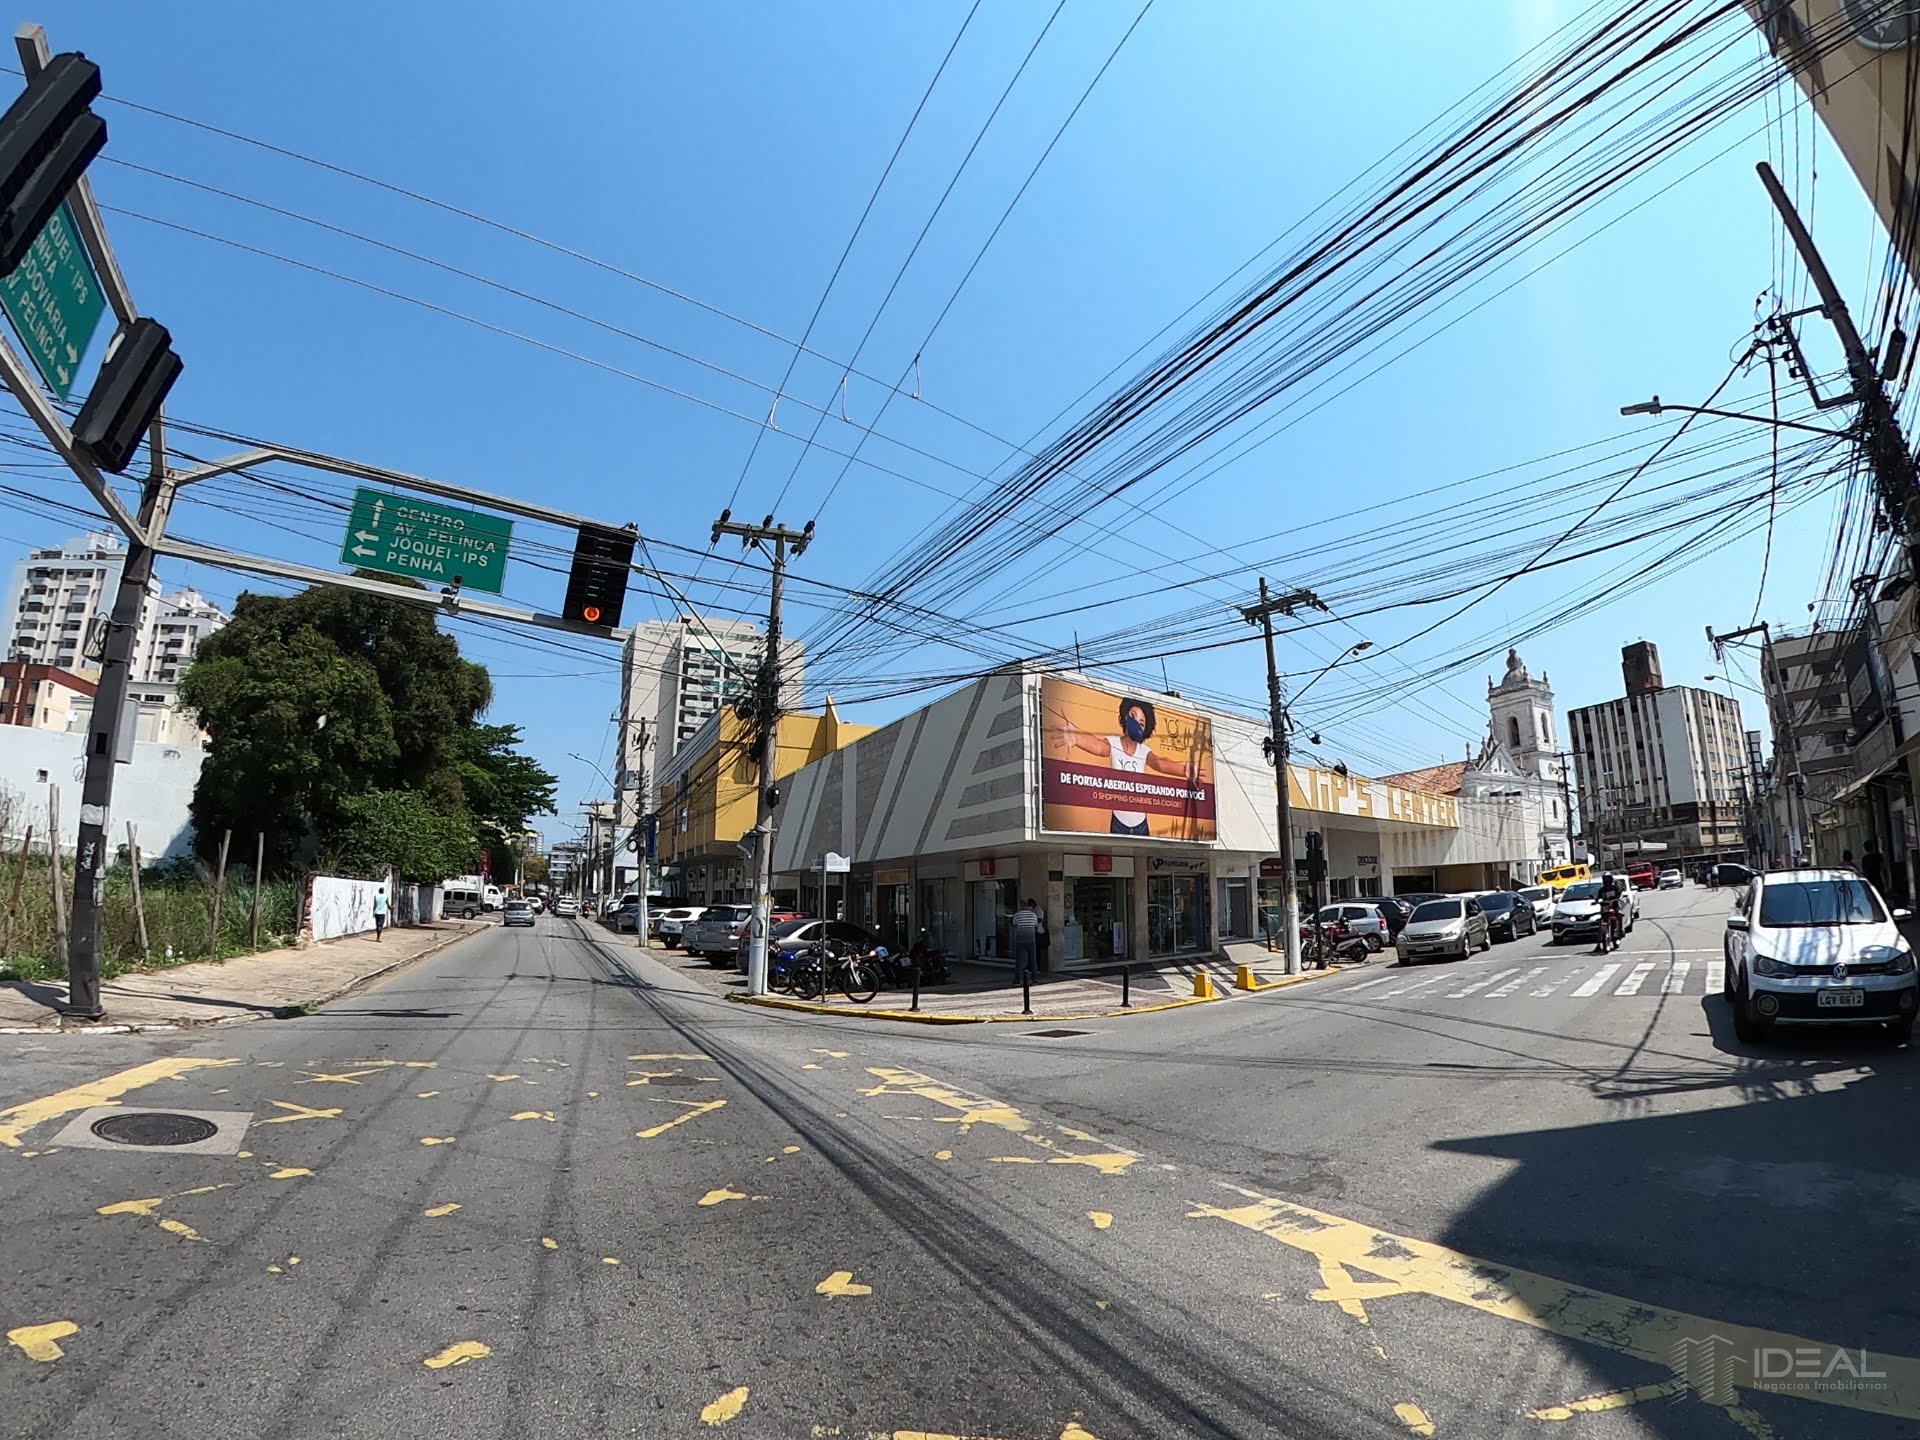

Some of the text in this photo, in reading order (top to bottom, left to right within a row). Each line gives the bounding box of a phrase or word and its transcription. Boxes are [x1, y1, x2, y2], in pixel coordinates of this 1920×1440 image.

[20, 249, 68, 344] ODOVIÁRIA
[19, 291, 57, 365] PELINCA
[396, 506, 466, 532] CENTRO
[393, 522, 496, 554] AV. PELINCA
[386, 552, 444, 574] PENHA
[1060, 772, 1206, 801] DE PORTAS ABERTAS ESPERANDO POR VOCÊ
[1092, 791, 1098, 799] O
[1098, 792, 1128, 803] SHOPPING
[1152, 798, 1161, 806] DA
[1387, 783, 1460, 829] CENTER
